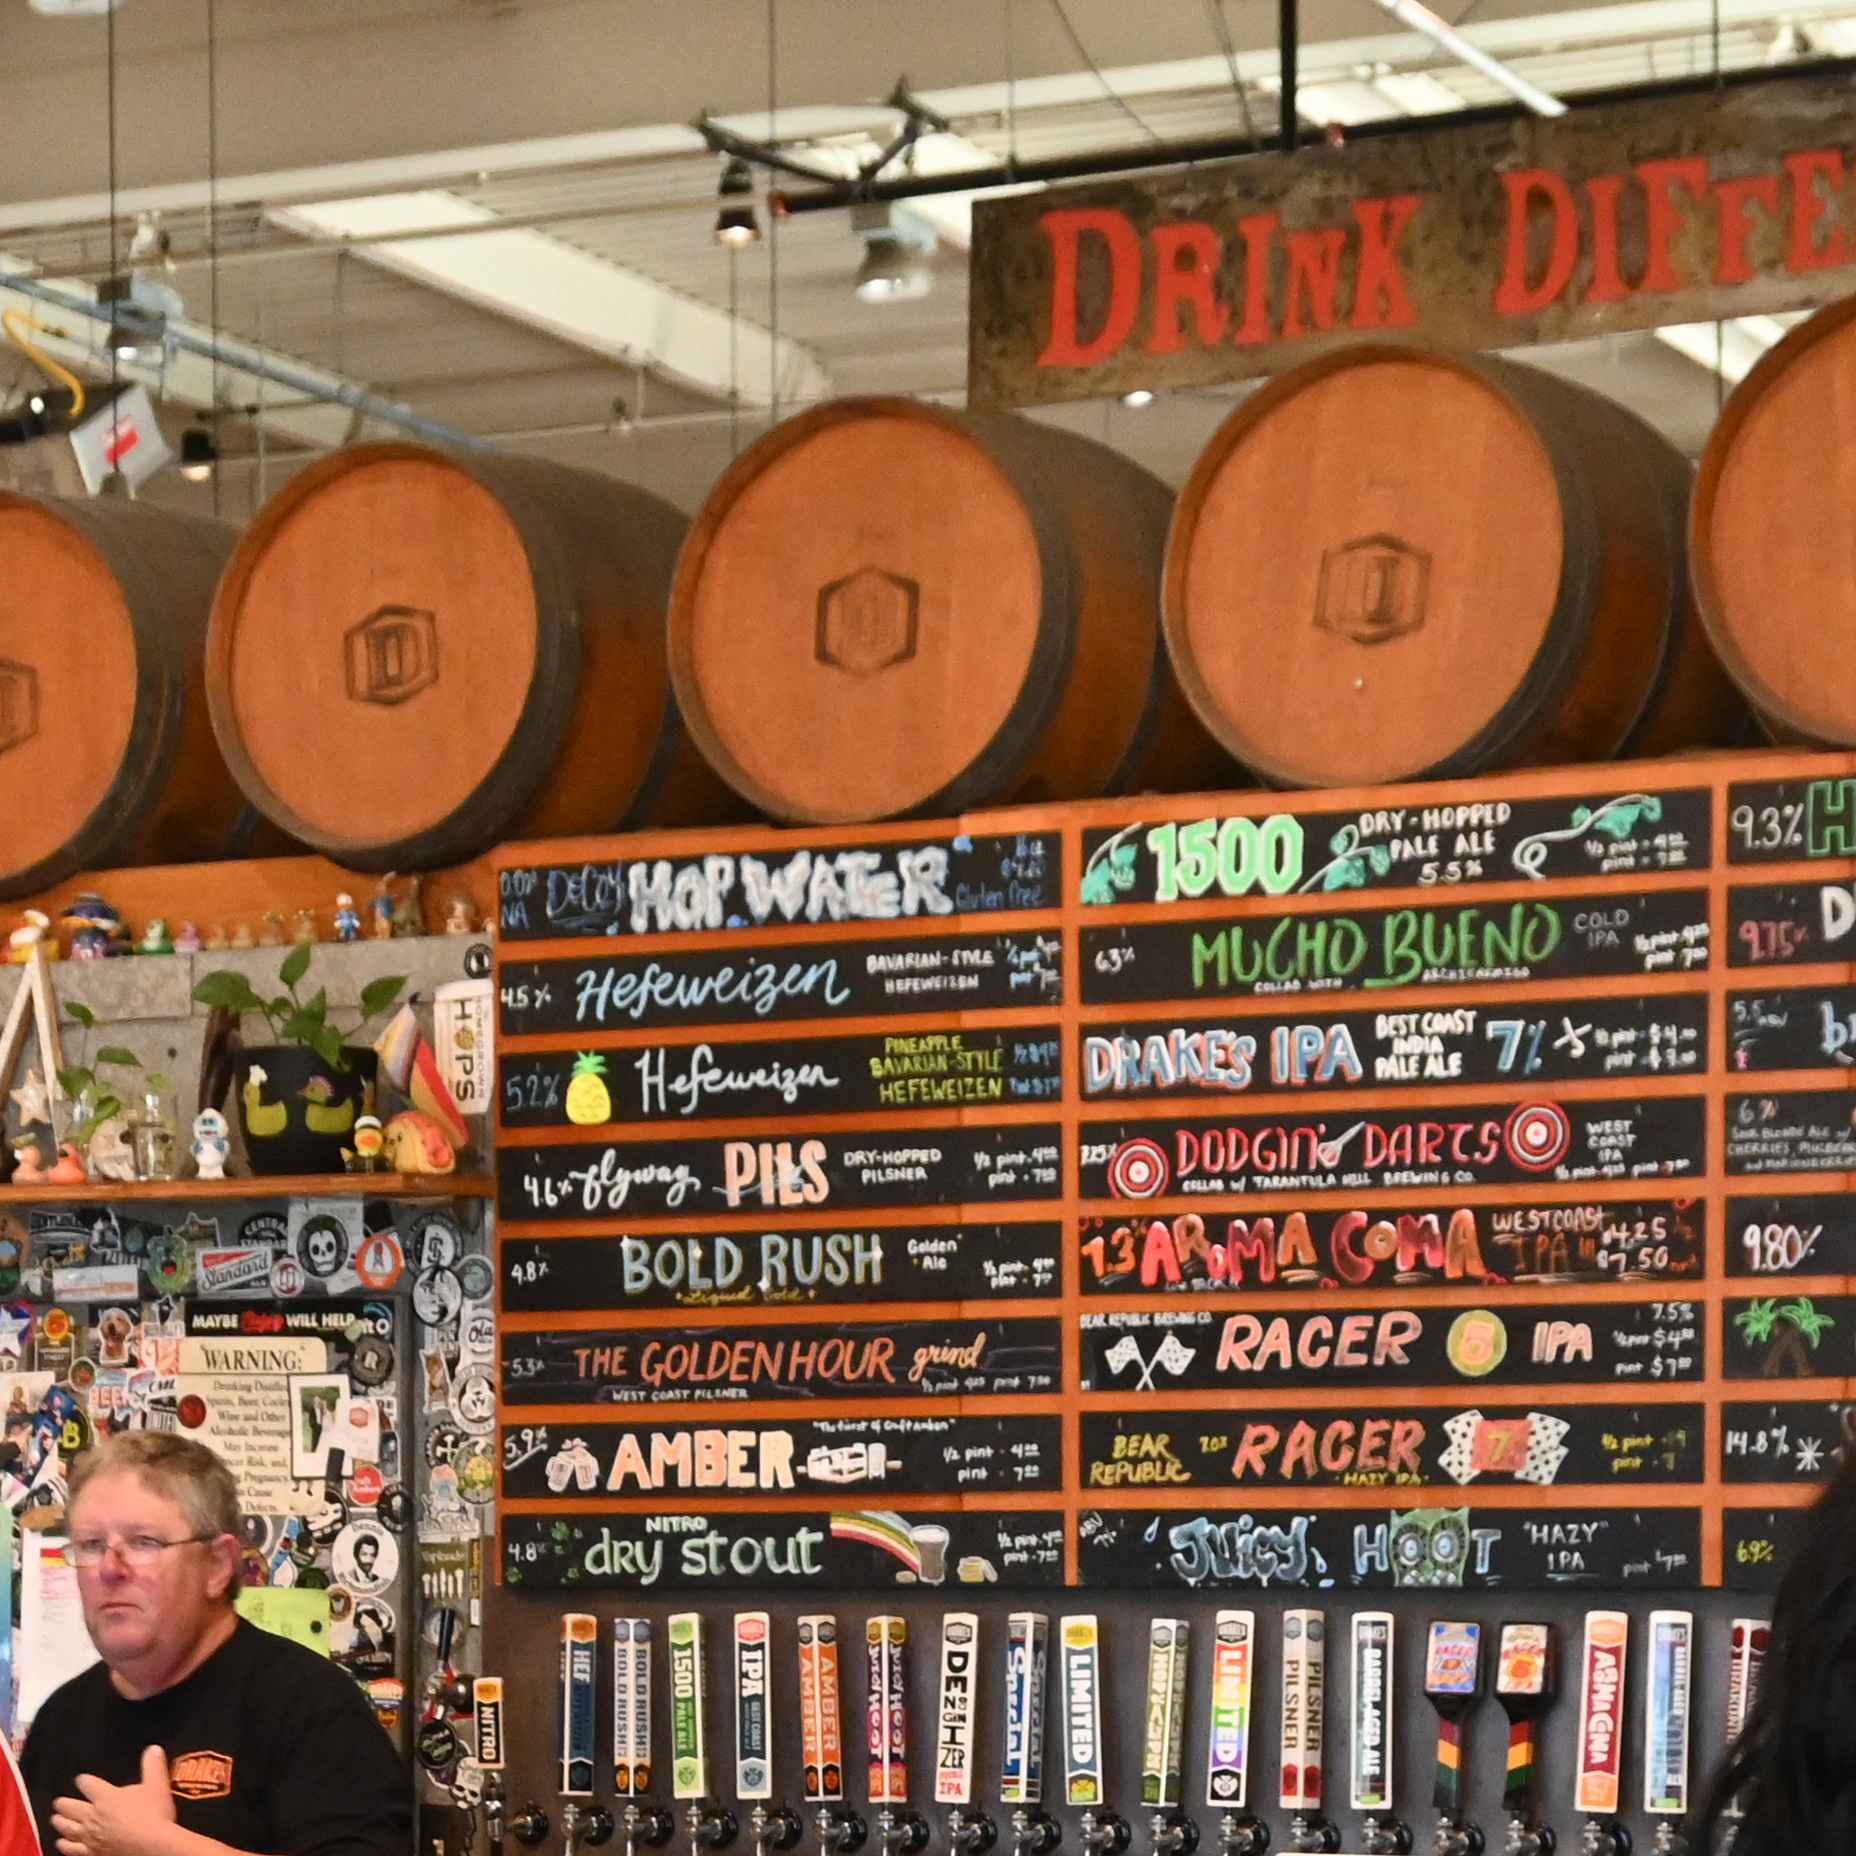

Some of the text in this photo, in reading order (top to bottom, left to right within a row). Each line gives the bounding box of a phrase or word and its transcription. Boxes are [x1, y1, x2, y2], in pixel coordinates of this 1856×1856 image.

[1037, 195, 1417, 368] DRINK
[1146, 813, 1305, 902] 1500
[1389, 830, 1497, 861] PALE ALE
[627, 855, 736, 933] HOP
[740, 845, 955, 924] WATER
[1190, 916, 1368, 989] MUCHO
[1362, 902, 1562, 990] BUENO
[1573, 908, 1631, 935] COLD
[1587, 928, 1621, 950] IPA
[574, 958, 851, 1023] Hefeweizen
[884, 1034, 966, 1056] PINEAPPLE
[1374, 1013, 1420, 1042] BEST
[1421, 1008, 1478, 1036] COAST
[1392, 1034, 1446, 1057] INDIA
[633, 1043, 841, 1115] Hefeweizen
[1269, 1022, 1365, 1091] IPA
[1374, 1050, 1463, 1081] PALE ALE
[879, 1075, 1004, 1104] HEFEWEIZEN
[1362, 1119, 1502, 1169] DARTS
[722, 1139, 832, 1207] PILS
[843, 1148, 943, 1168] DRY-HOPPED
[860, 1167, 929, 1186] PILSNER
[621, 1233, 744, 1296] BOLD
[759, 1230, 885, 1290] RUSH
[906, 1238, 959, 1256] Golden
[921, 1254, 948, 1272] Ale
[192, 1314, 239, 1329] MAYBE
[285, 1313, 319, 1328] WILL
[1216, 1310, 1423, 1373] RACER
[1457, 1319, 1496, 1366] 5
[1531, 1320, 1594, 1364] IPA
[574, 1345, 629, 1380] THE
[639, 1339, 785, 1389] GOLDEN
[787, 1335, 898, 1384] HOUR
[611, 1385, 750, 1402] WEST COAST PILSNER
[605, 1428, 798, 1493] AMBER
[1089, 1458, 1193, 1487] REPUBLIC
[1111, 1417, 1514, 1479] BEAR RACER 7
[1343, 1469, 1423, 1487] HAZY IPA
[645, 1514, 709, 1535] NITRO
[584, 1525, 825, 1587] dry stout
[1546, 1551, 1585, 1573] IPA
[672, 1648, 694, 1699] 1500
[740, 1649, 764, 1698] IPA
[819, 1655, 838, 1751] AMBER
[1069, 1653, 1094, 1765] LIMITED
[1306, 1660, 1323, 1753] PILSNER
[479, 1704, 497, 1761] NITRO
